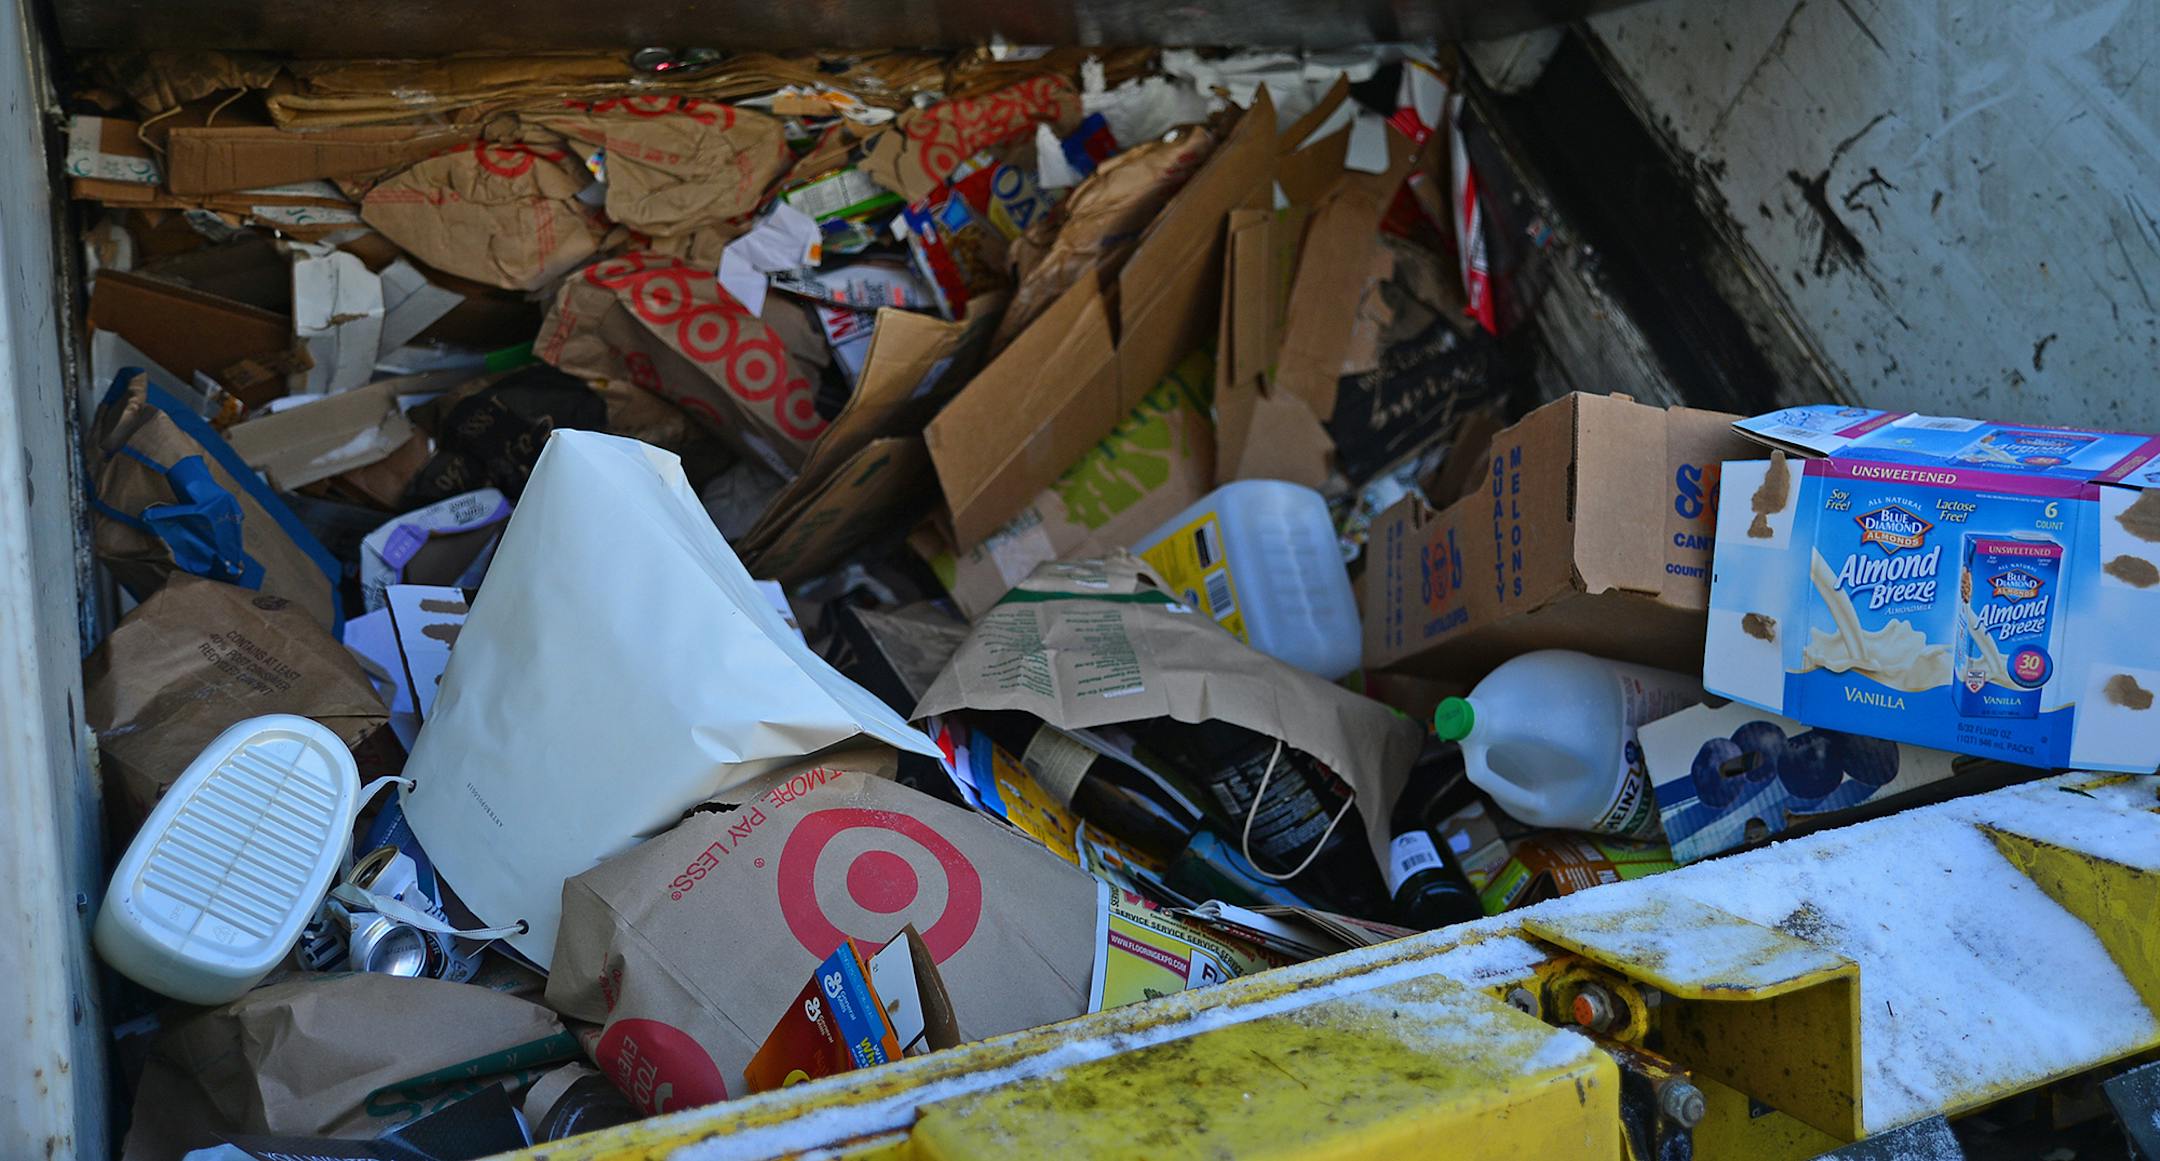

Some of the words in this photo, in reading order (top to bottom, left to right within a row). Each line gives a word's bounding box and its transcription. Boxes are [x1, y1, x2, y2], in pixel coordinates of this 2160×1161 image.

[1851, 465, 1957, 485] UNSWEETENED
[1830, 489, 1850, 501] Soy
[1868, 497, 1883, 507] ALL
[1885, 496, 1922, 512] NATURAL
[1825, 499, 1851, 512] Free!
[1936, 499, 1976, 512] Lactose
[2044, 501, 2059, 519] 6
[1510, 445, 1522, 597] MELONS
[1865, 517, 1923, 534] DIAMOND
[1880, 510, 1910, 524] BLUE
[1939, 510, 1967, 523] Free!
[2035, 520, 2065, 531] COUNT
[1492, 455, 1505, 603] QUALITY
[1867, 532, 1920, 547] ALMONDS
[1988, 545, 2051, 557] UNSWEETENED
[1834, 545, 1941, 589] Almond
[1995, 578, 2037, 589] DIAMOND
[1869, 580, 1937, 611] Breeze
[1974, 595, 2049, 630] Almond
[1999, 617, 2046, 641] Breeze
[226, 630, 268, 661] CONTAINS
[2019, 654, 2041, 670] 30
[1844, 686, 1905, 710] VANILLA
[1983, 695, 2022, 706] VANILLA
[1975, 723, 1999, 738] FLUID
[2000, 729, 2013, 740] OZ
[2007, 741, 2035, 755] PACKS
[761, 767, 826, 808] MORE.
[1606, 778, 1640, 830] HEINZ
[728, 806, 767, 847] PAY
[1115, 908, 1148, 926] SERVICE
[1151, 921, 1185, 938] SERVICE
[1187, 933, 1219, 951] SERVICE
[836, 994, 848, 1014] Mills
[840, 990, 857, 1021] General
[818, 1014, 834, 1044] General
